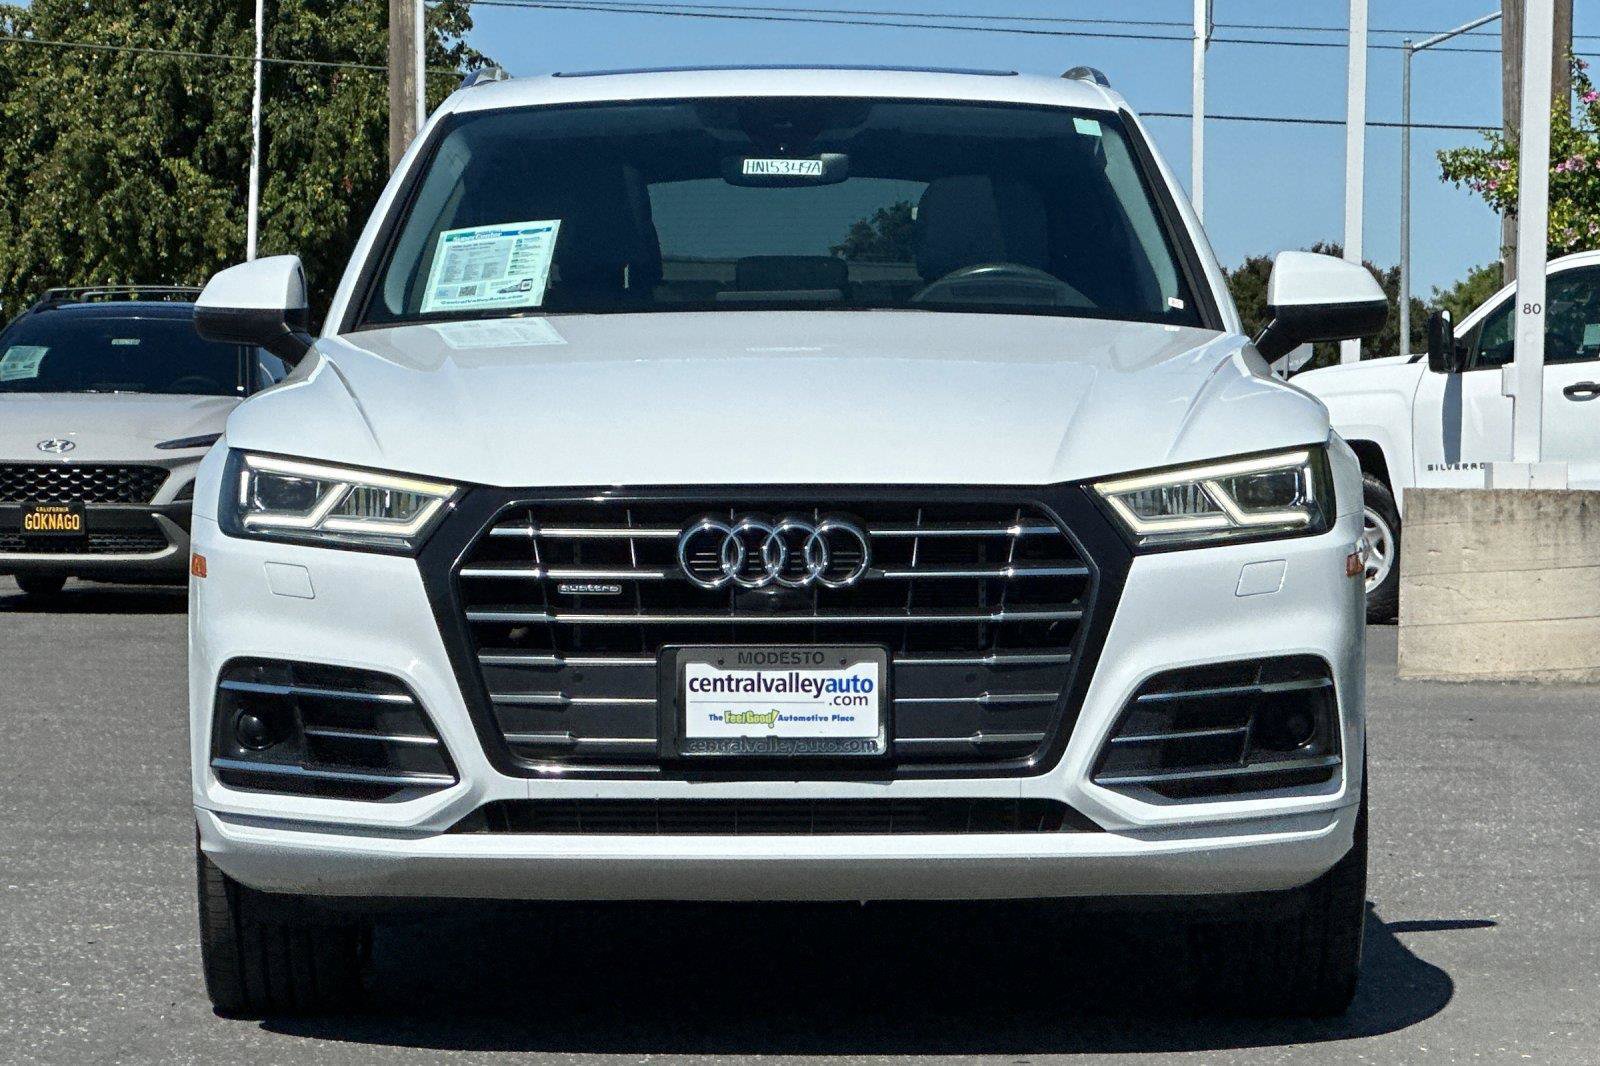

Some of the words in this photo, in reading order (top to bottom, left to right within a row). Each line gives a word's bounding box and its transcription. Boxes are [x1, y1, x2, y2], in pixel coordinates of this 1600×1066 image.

[1522, 303, 1542, 315] 80
[1427, 462, 1486, 471] SILVERAD
[25, 513, 80, 530] GOKNAGO
[561, 584, 619, 592] quattro
[737, 651, 826, 666] MODESTO
[688, 672, 874, 698] centralvalleyauto
[828, 694, 869, 707] .com
[708, 713, 724, 722] The
[777, 713, 829, 722] Automotive
[831, 713, 855, 722] Place
[688, 735, 879, 756] centralvalleyauto.com
